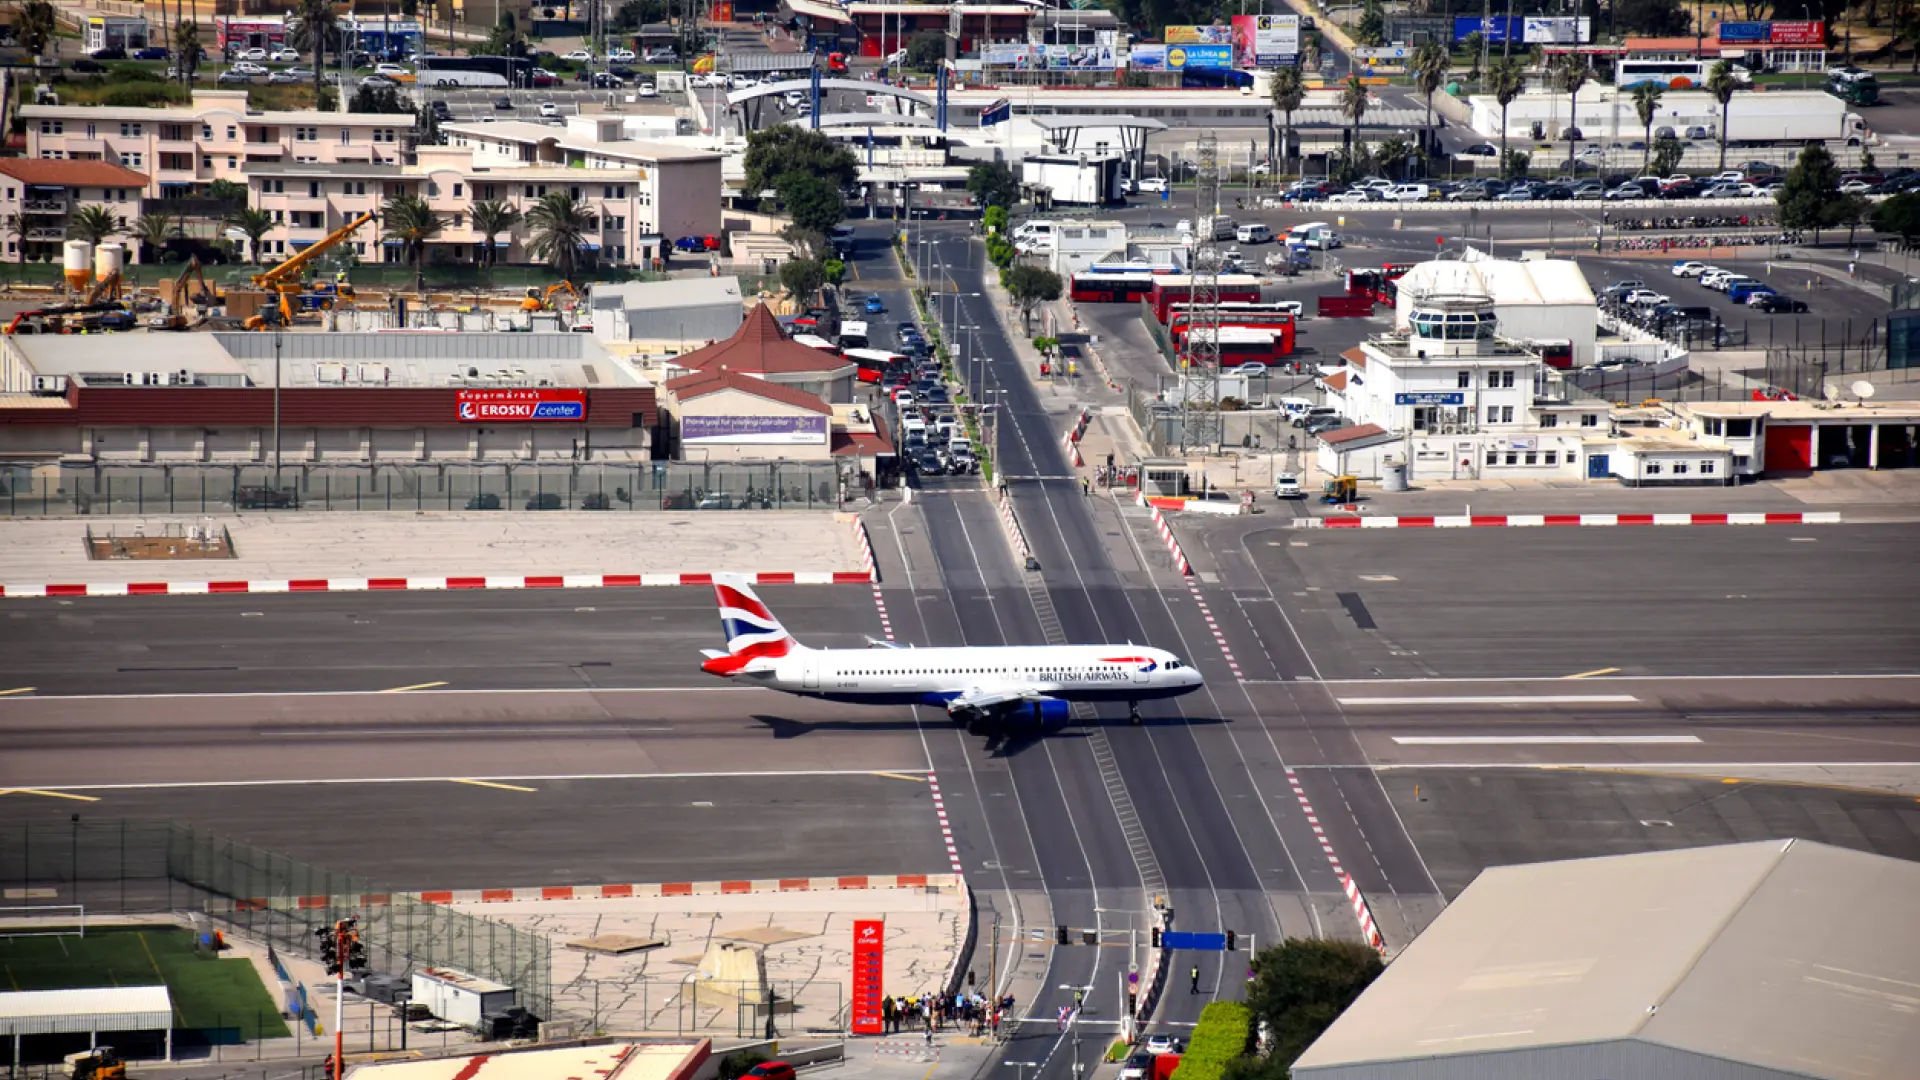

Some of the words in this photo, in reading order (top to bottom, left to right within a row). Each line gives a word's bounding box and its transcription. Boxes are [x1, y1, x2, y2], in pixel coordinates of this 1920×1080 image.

[481, 404, 531, 416] EROSKI
[538, 405, 577, 416] center
[1039, 672, 1082, 682] BRITISH
[1083, 671, 1129, 681] AIRWAYS
